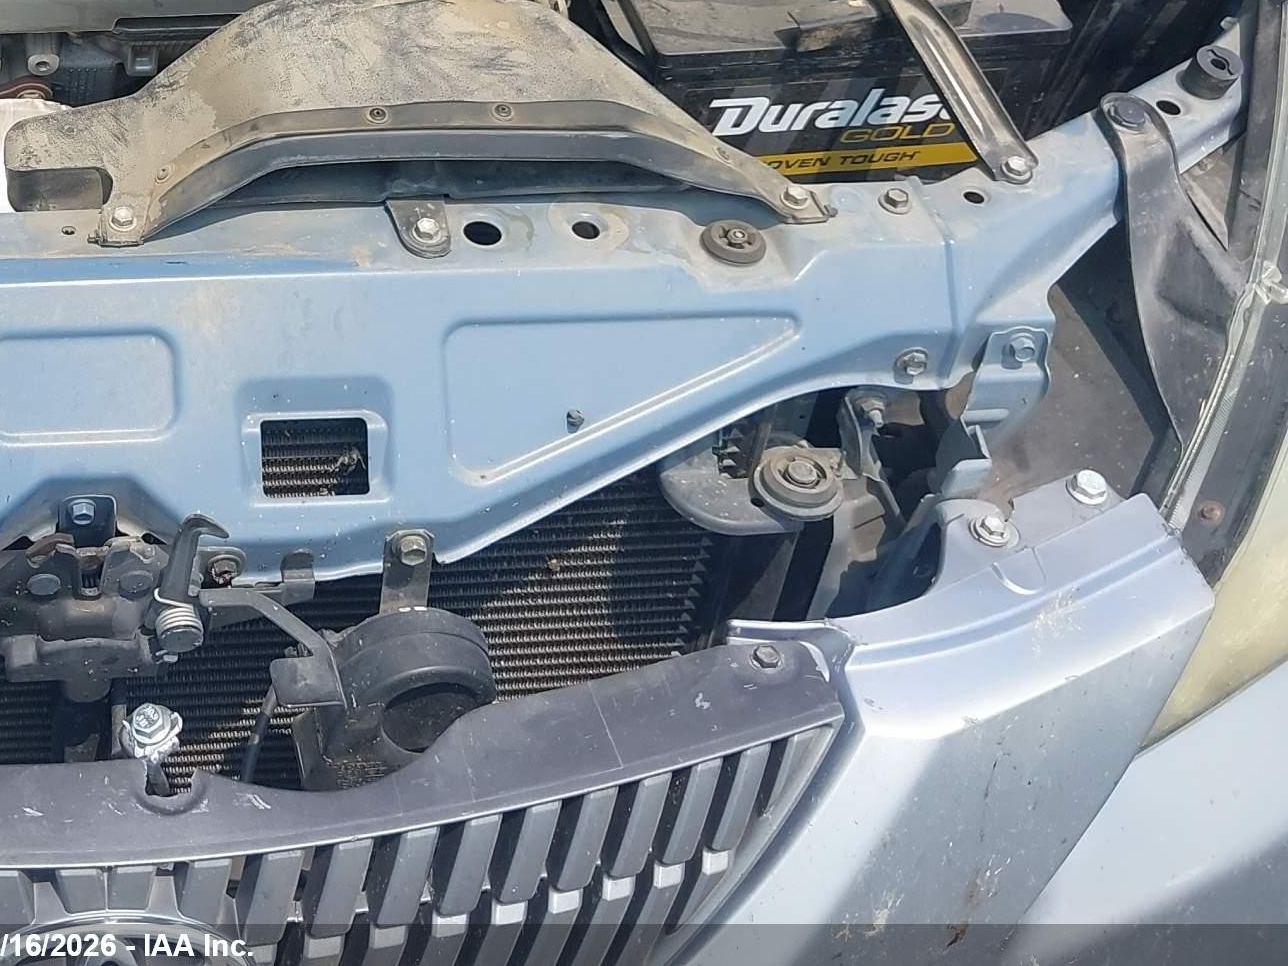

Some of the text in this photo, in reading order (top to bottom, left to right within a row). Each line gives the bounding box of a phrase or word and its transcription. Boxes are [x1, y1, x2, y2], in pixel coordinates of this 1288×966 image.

[709, 89, 952, 136] Duralas
[840, 122, 956, 143] GOLD
[764, 150, 919, 170] OVEN TOUGH
